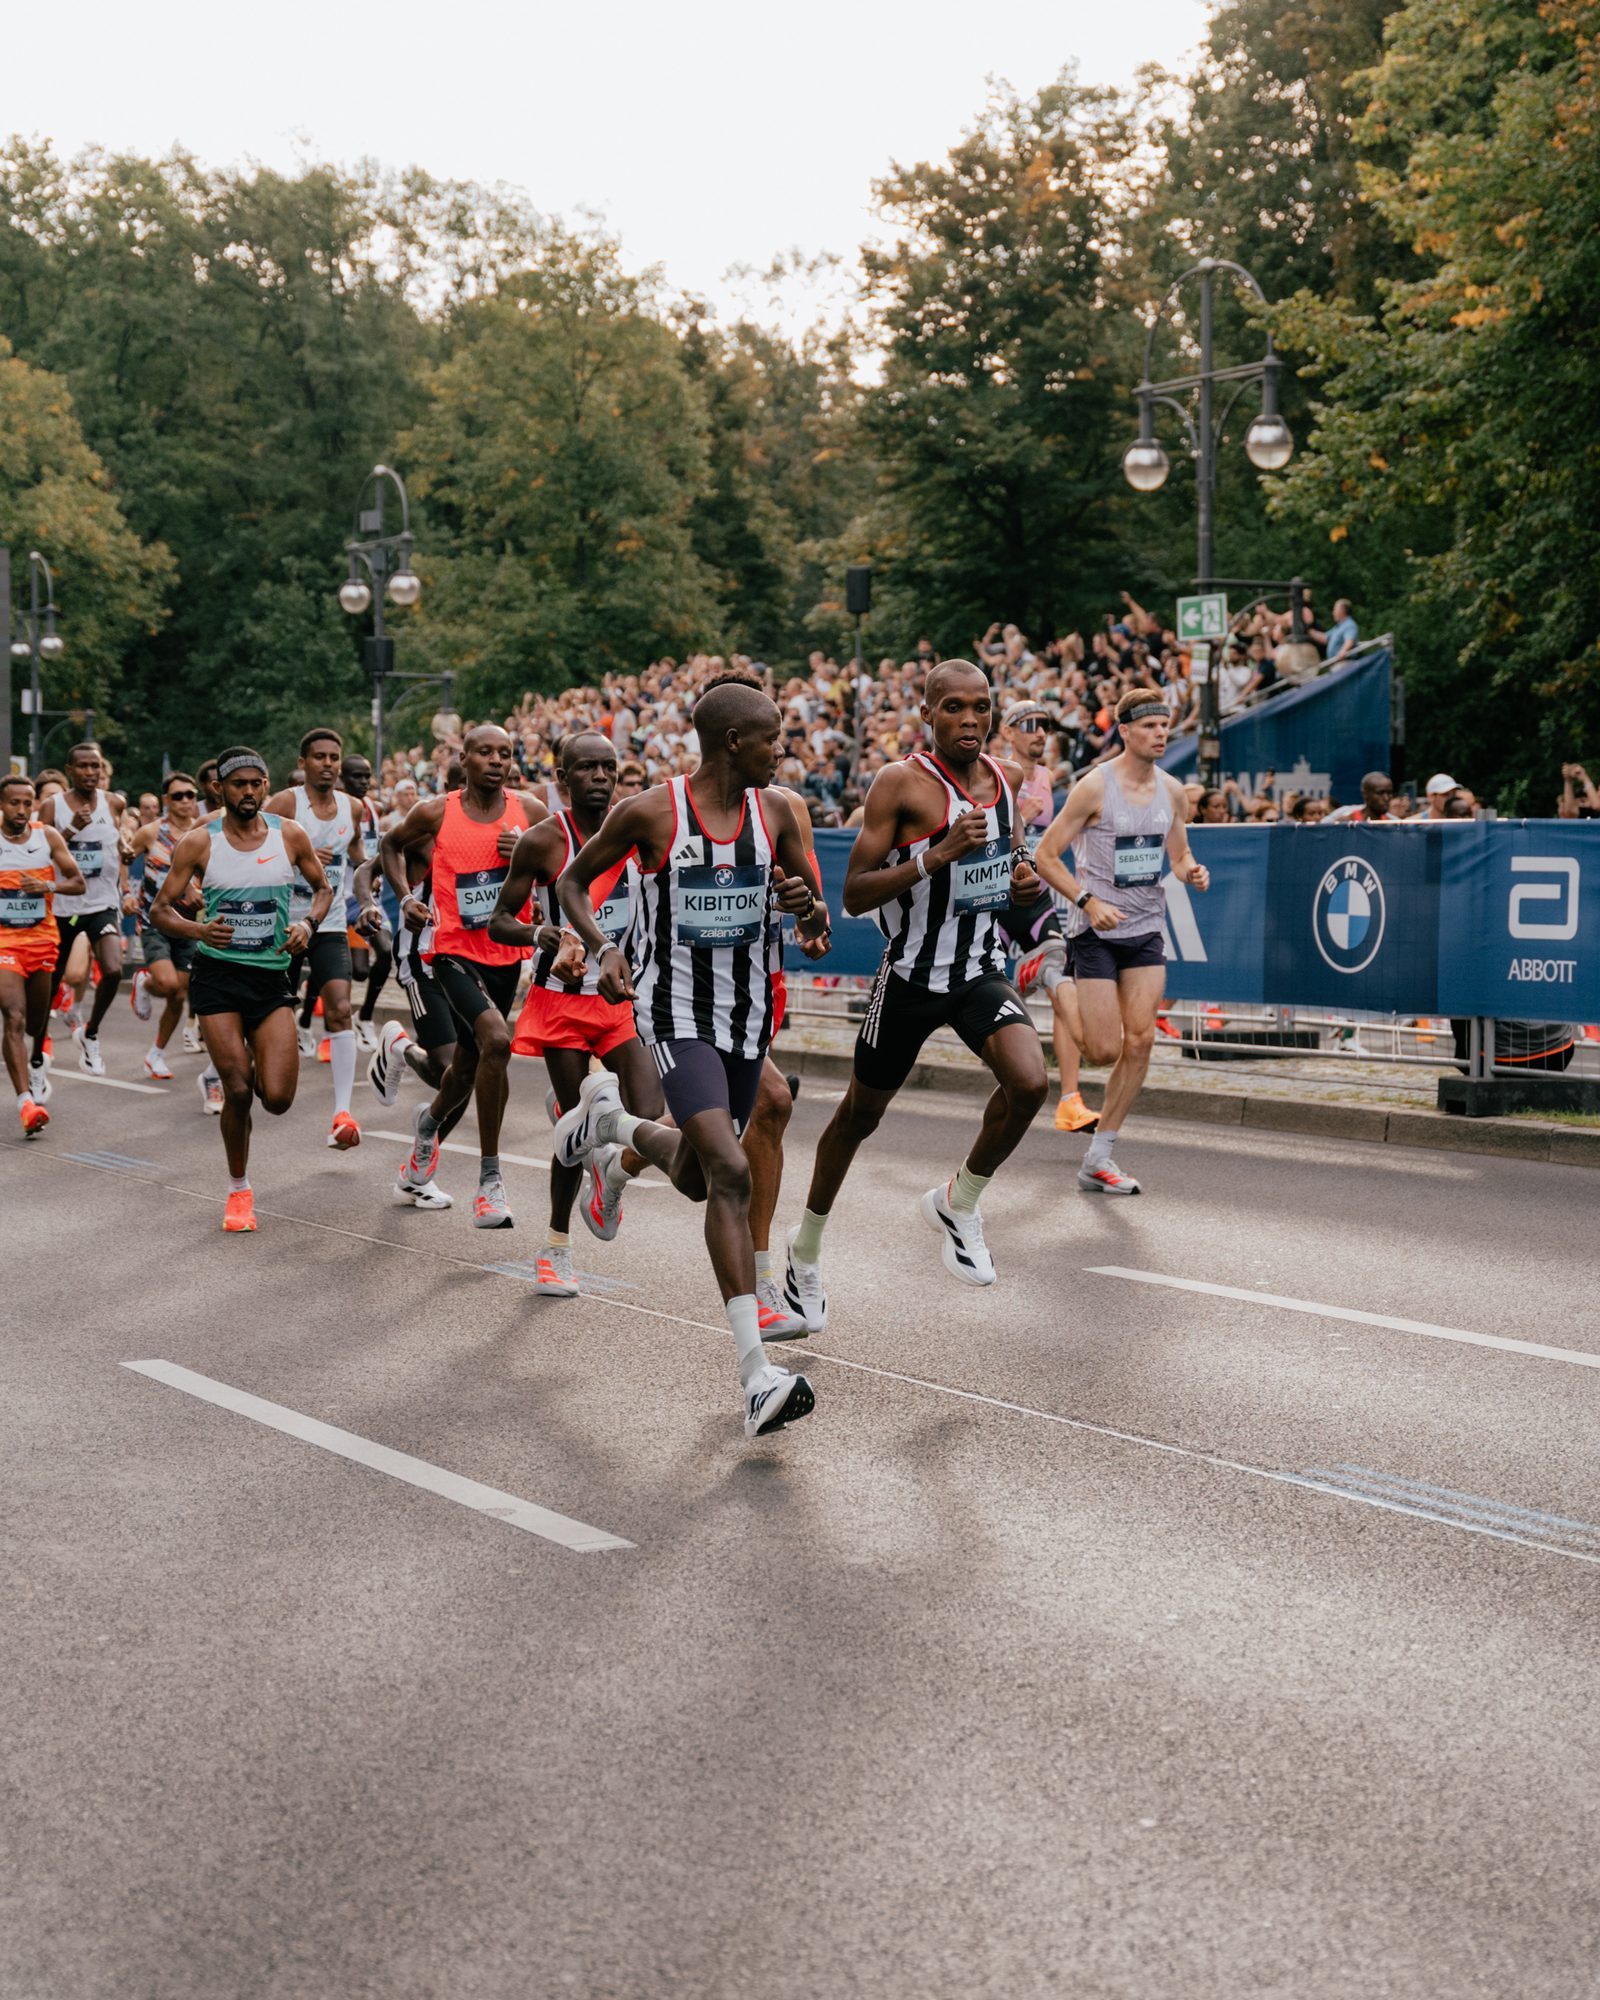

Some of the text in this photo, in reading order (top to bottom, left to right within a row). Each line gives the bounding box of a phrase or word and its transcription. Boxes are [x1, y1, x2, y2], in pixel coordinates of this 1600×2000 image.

[1118, 853, 1160, 864] SEBASTIAN
[1324, 862, 1377, 895] BMW
[6, 901, 39, 911] ALEW
[684, 892, 760, 911] KIBITOK
[972, 892, 1008, 907] zalando
[699, 927, 746, 939] zalando
[1507, 958, 1578, 983] ABBOTT
